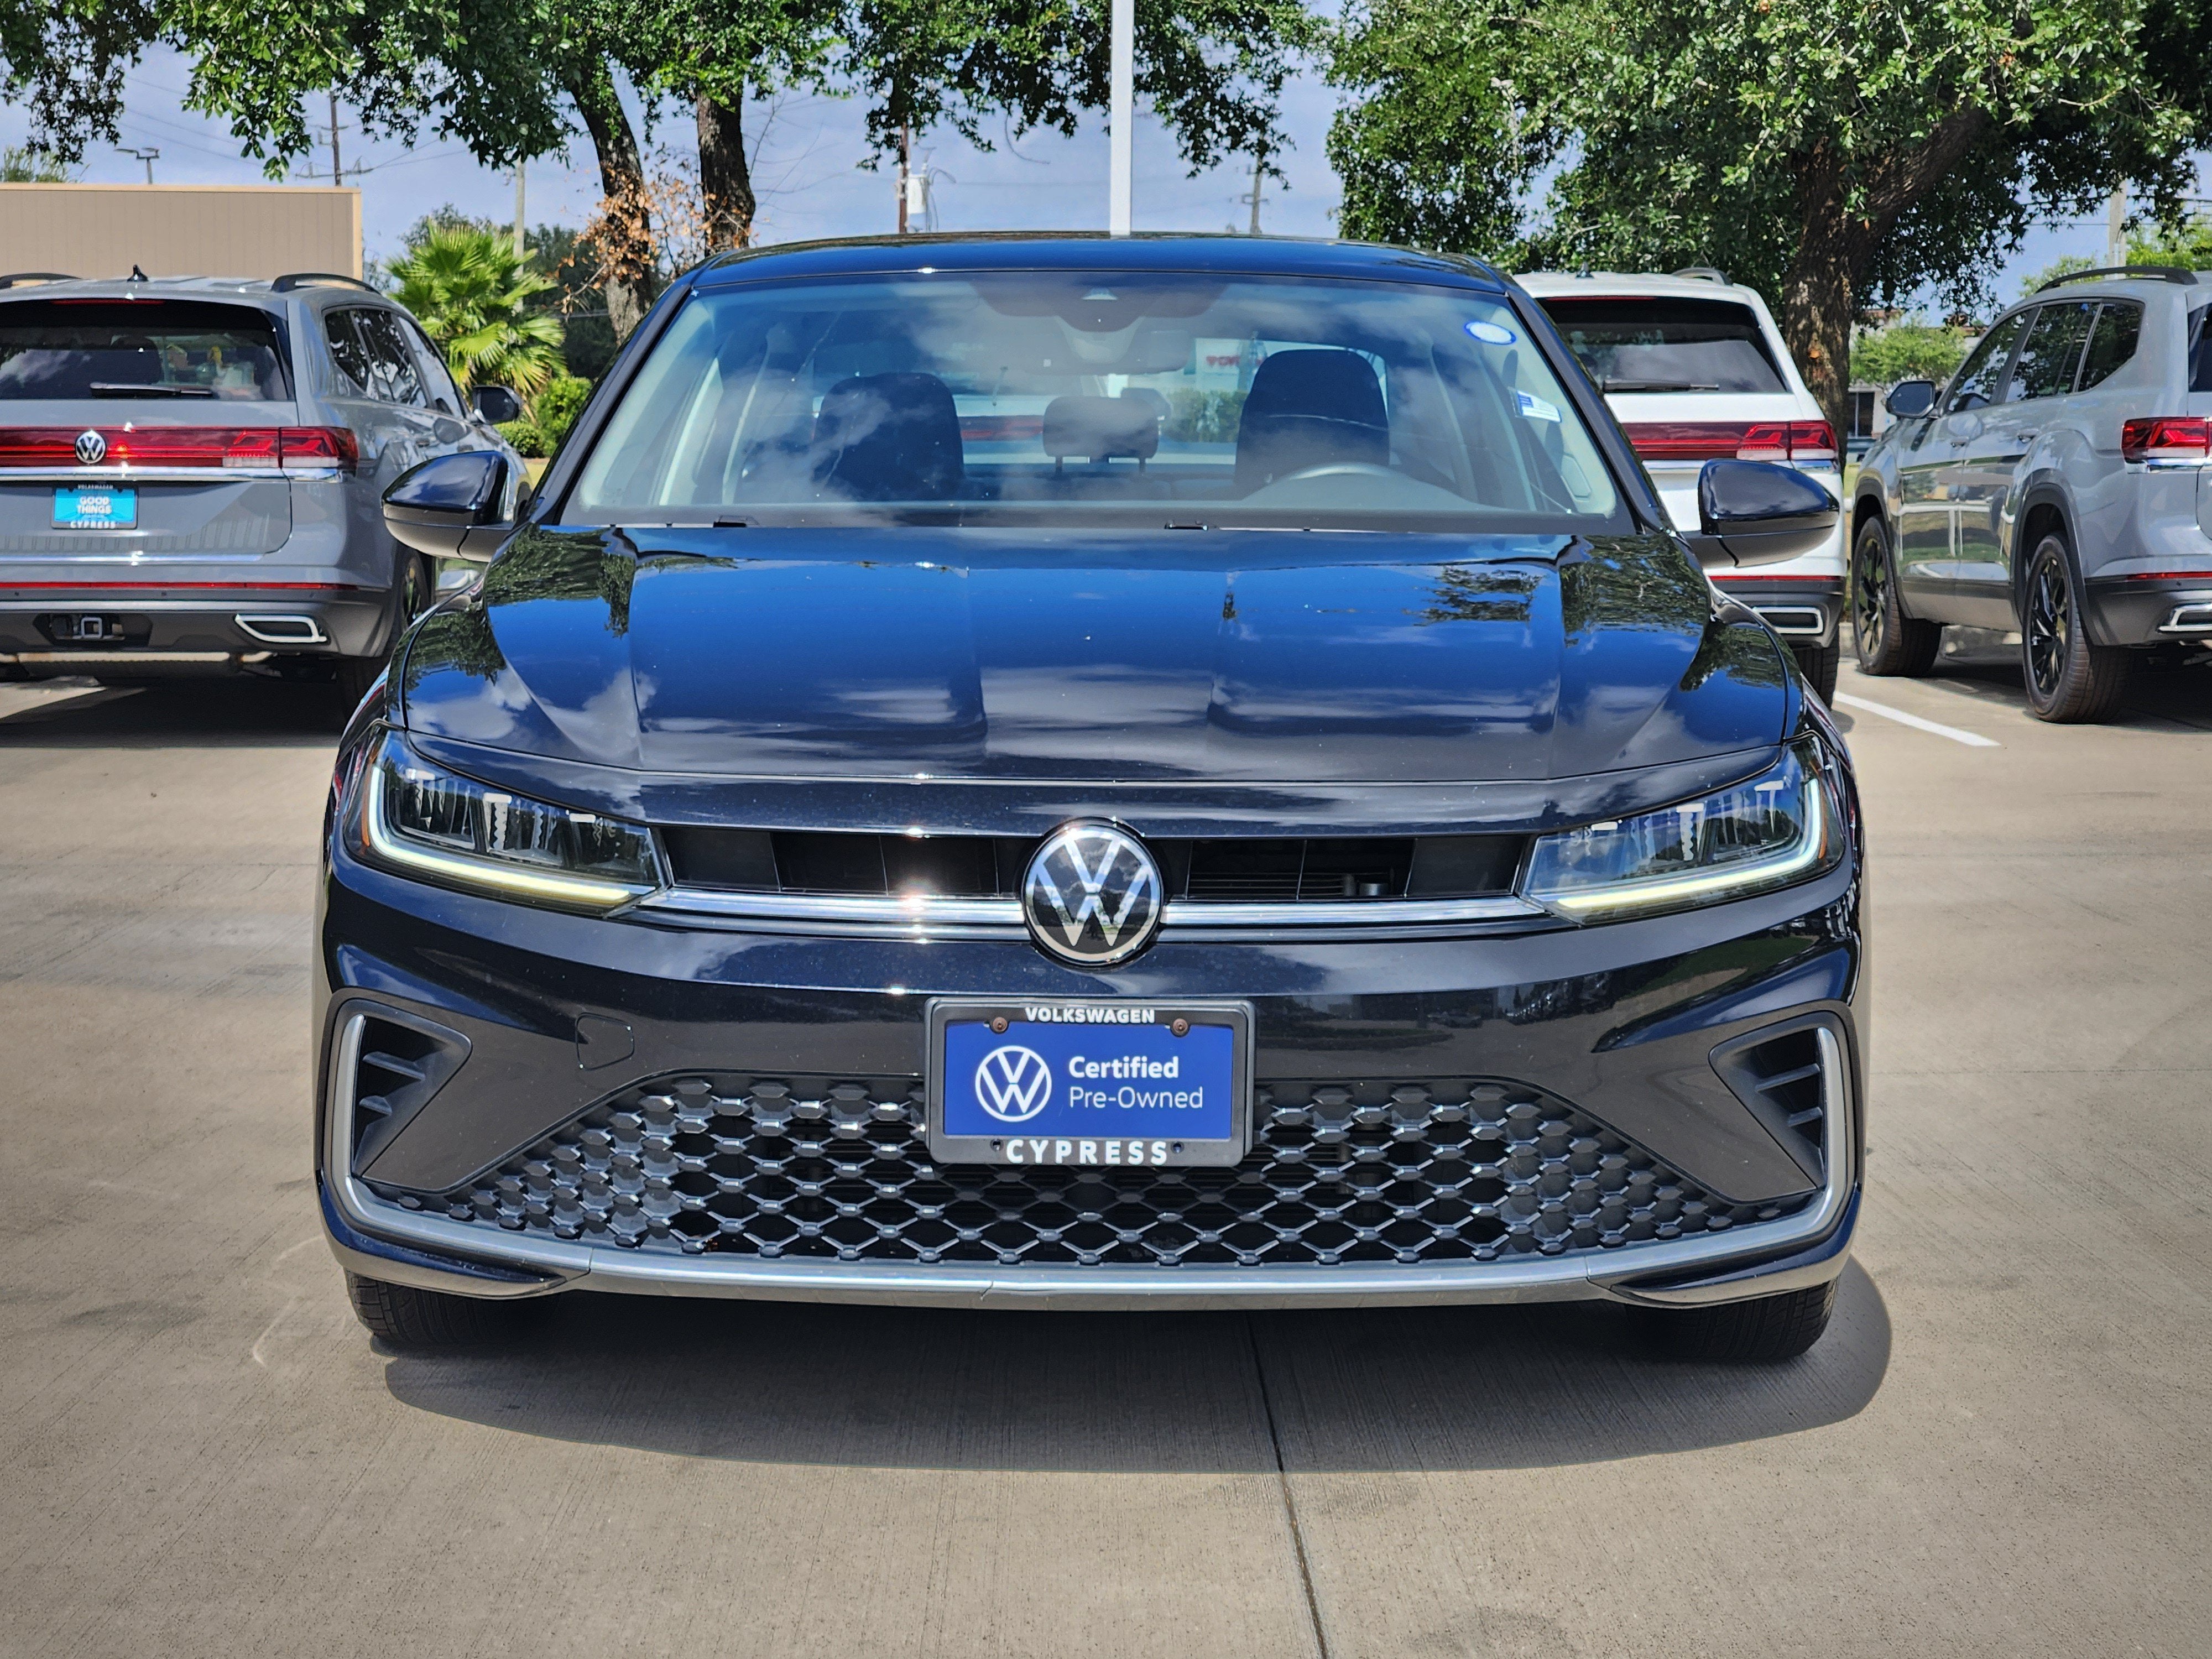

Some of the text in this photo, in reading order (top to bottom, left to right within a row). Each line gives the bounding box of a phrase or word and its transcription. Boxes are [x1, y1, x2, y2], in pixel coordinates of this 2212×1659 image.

[77, 505, 112, 514] THINGS
[80, 496, 109, 505] GOOD
[1027, 831, 1159, 958] VW
[1025, 1007, 1155, 1023] VOLKSWAGEN
[1068, 1056, 1178, 1078] Certified
[976, 1046, 1051, 1120] VW
[1070, 1086, 1203, 1108] Pre-Owned
[1006, 1140, 1167, 1165] CYPRESS
